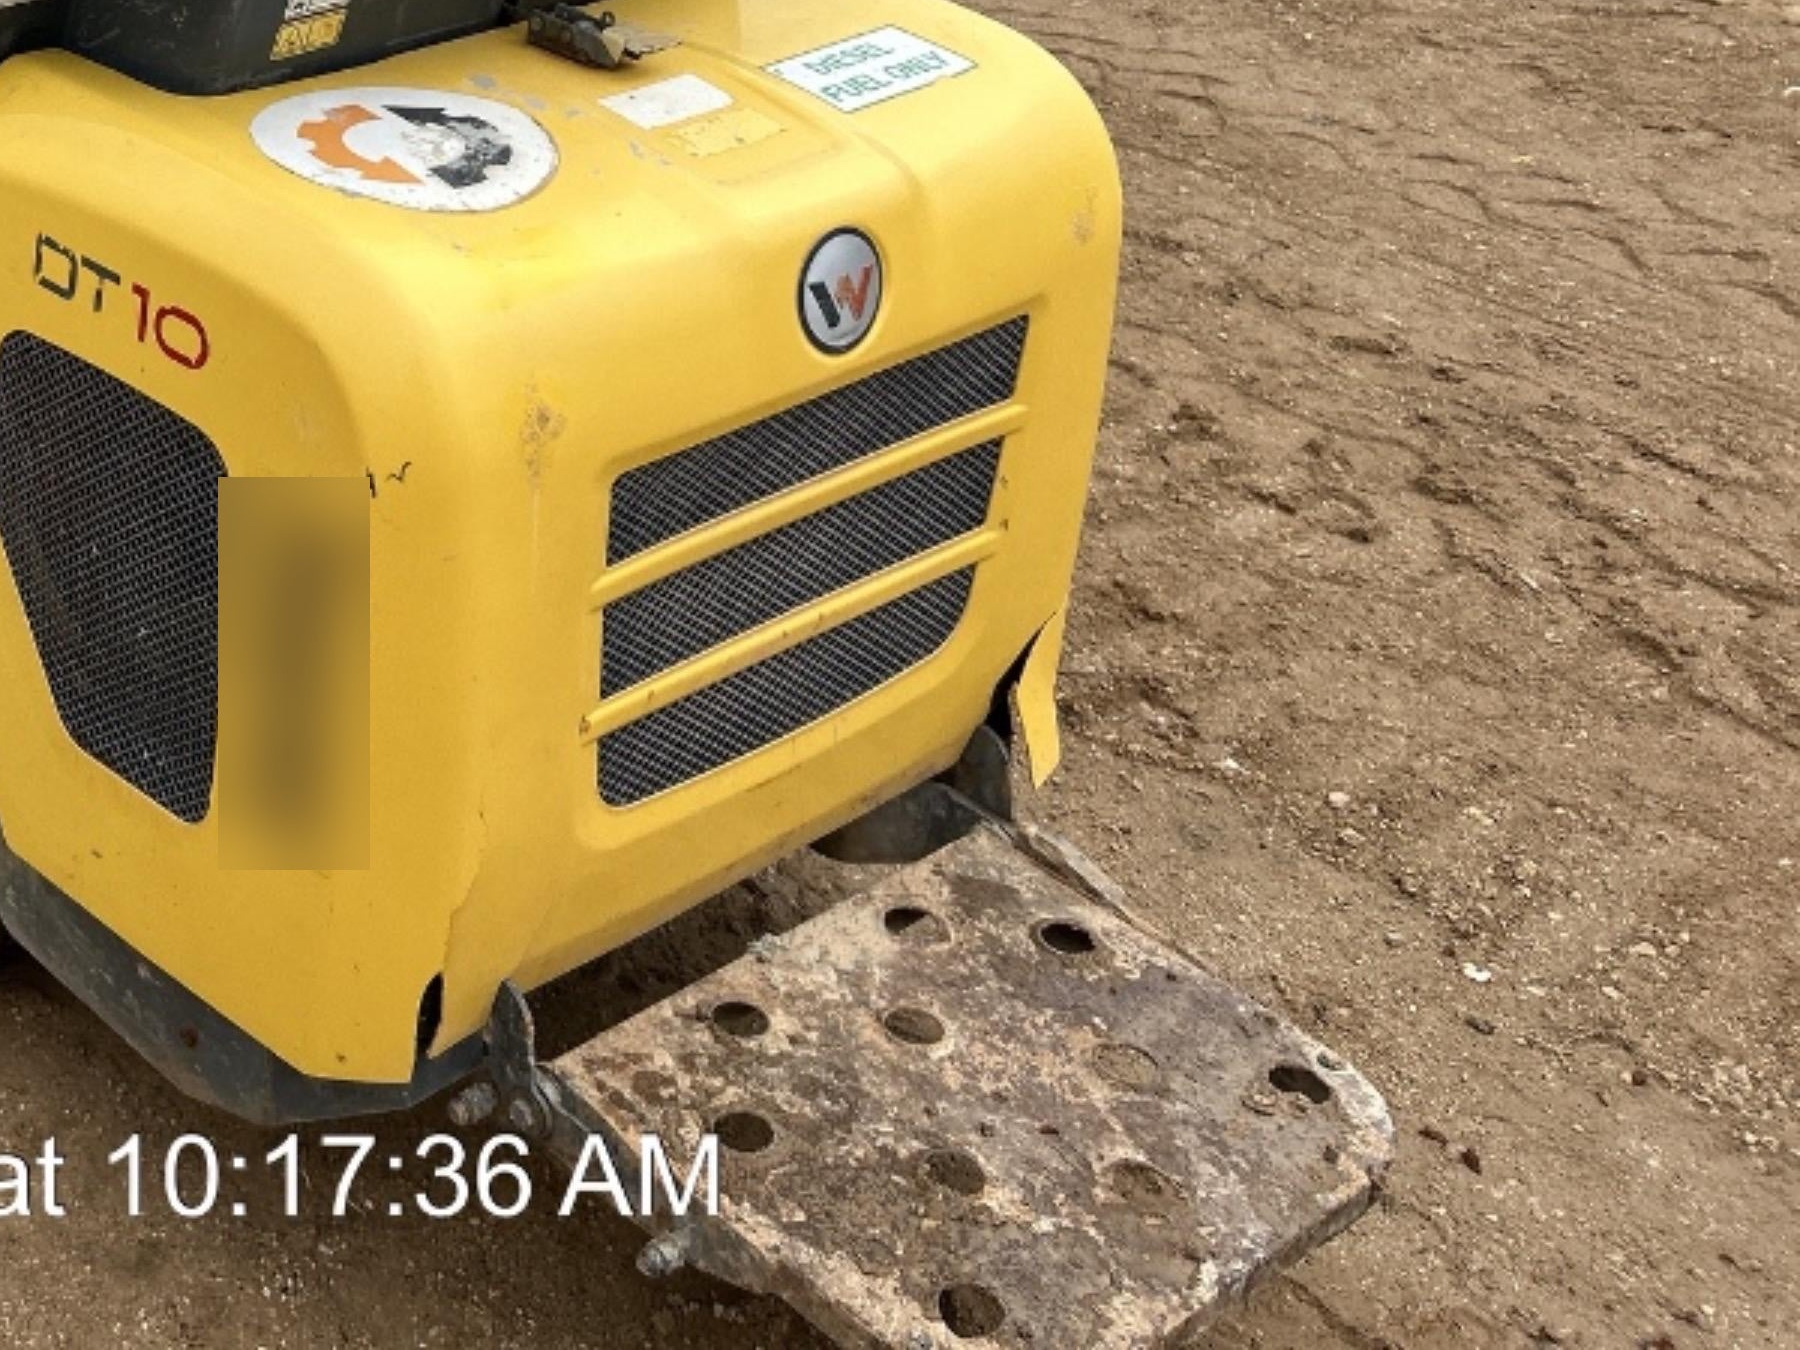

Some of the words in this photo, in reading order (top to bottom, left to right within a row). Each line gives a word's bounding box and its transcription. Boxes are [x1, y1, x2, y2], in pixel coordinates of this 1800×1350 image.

[802, 42, 896, 76] DIESEL
[820, 73, 894, 102] FUEL
[881, 50, 949, 80] ONLY
